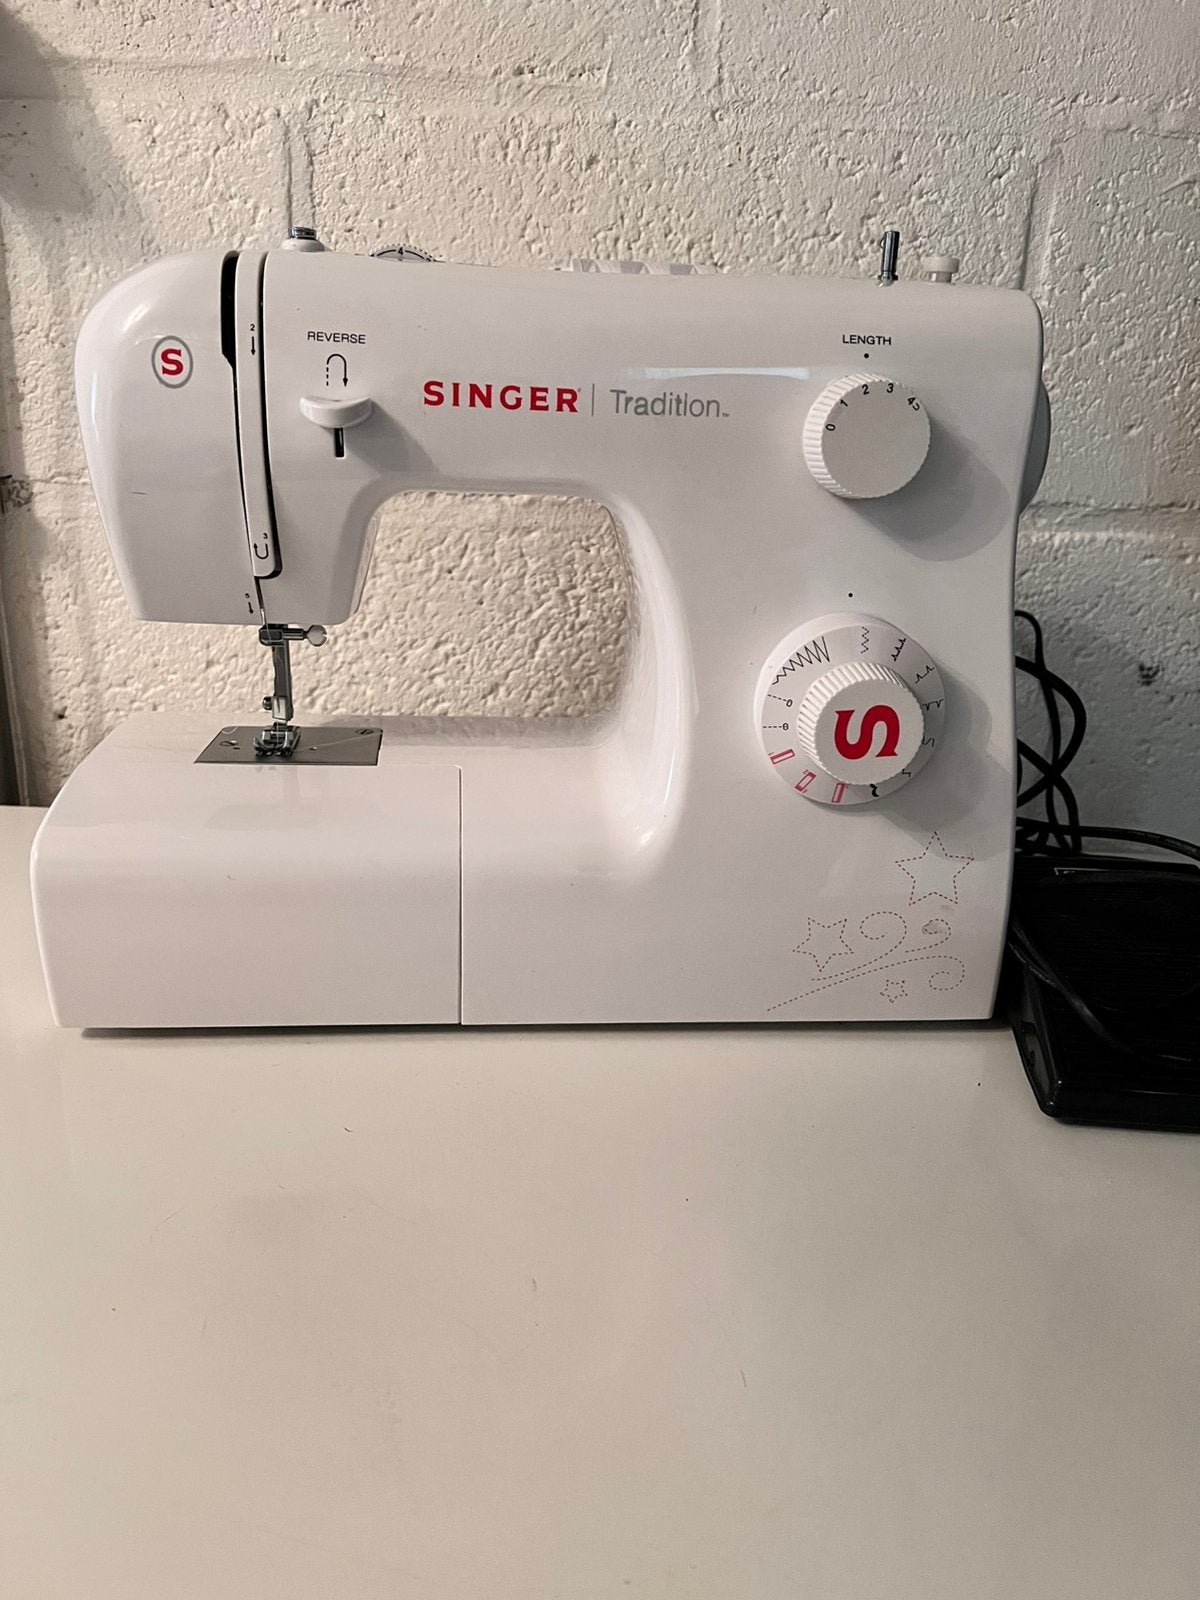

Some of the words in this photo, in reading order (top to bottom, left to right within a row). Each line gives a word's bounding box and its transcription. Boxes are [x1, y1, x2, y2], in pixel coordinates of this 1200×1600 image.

[249, 323, 256, 332] 2
[307, 330, 366, 345] REVERSE
[842, 334, 892, 346] LENGTH
[160, 348, 184, 376] S
[423, 380, 578, 413] SINGER
[609, 389, 721, 418] Tradition
[825, 423, 837, 432] 0
[840, 398, 849, 408] 1
[861, 383, 870, 396] 2
[886, 382, 894, 394] 3
[834, 704, 900, 760] S
